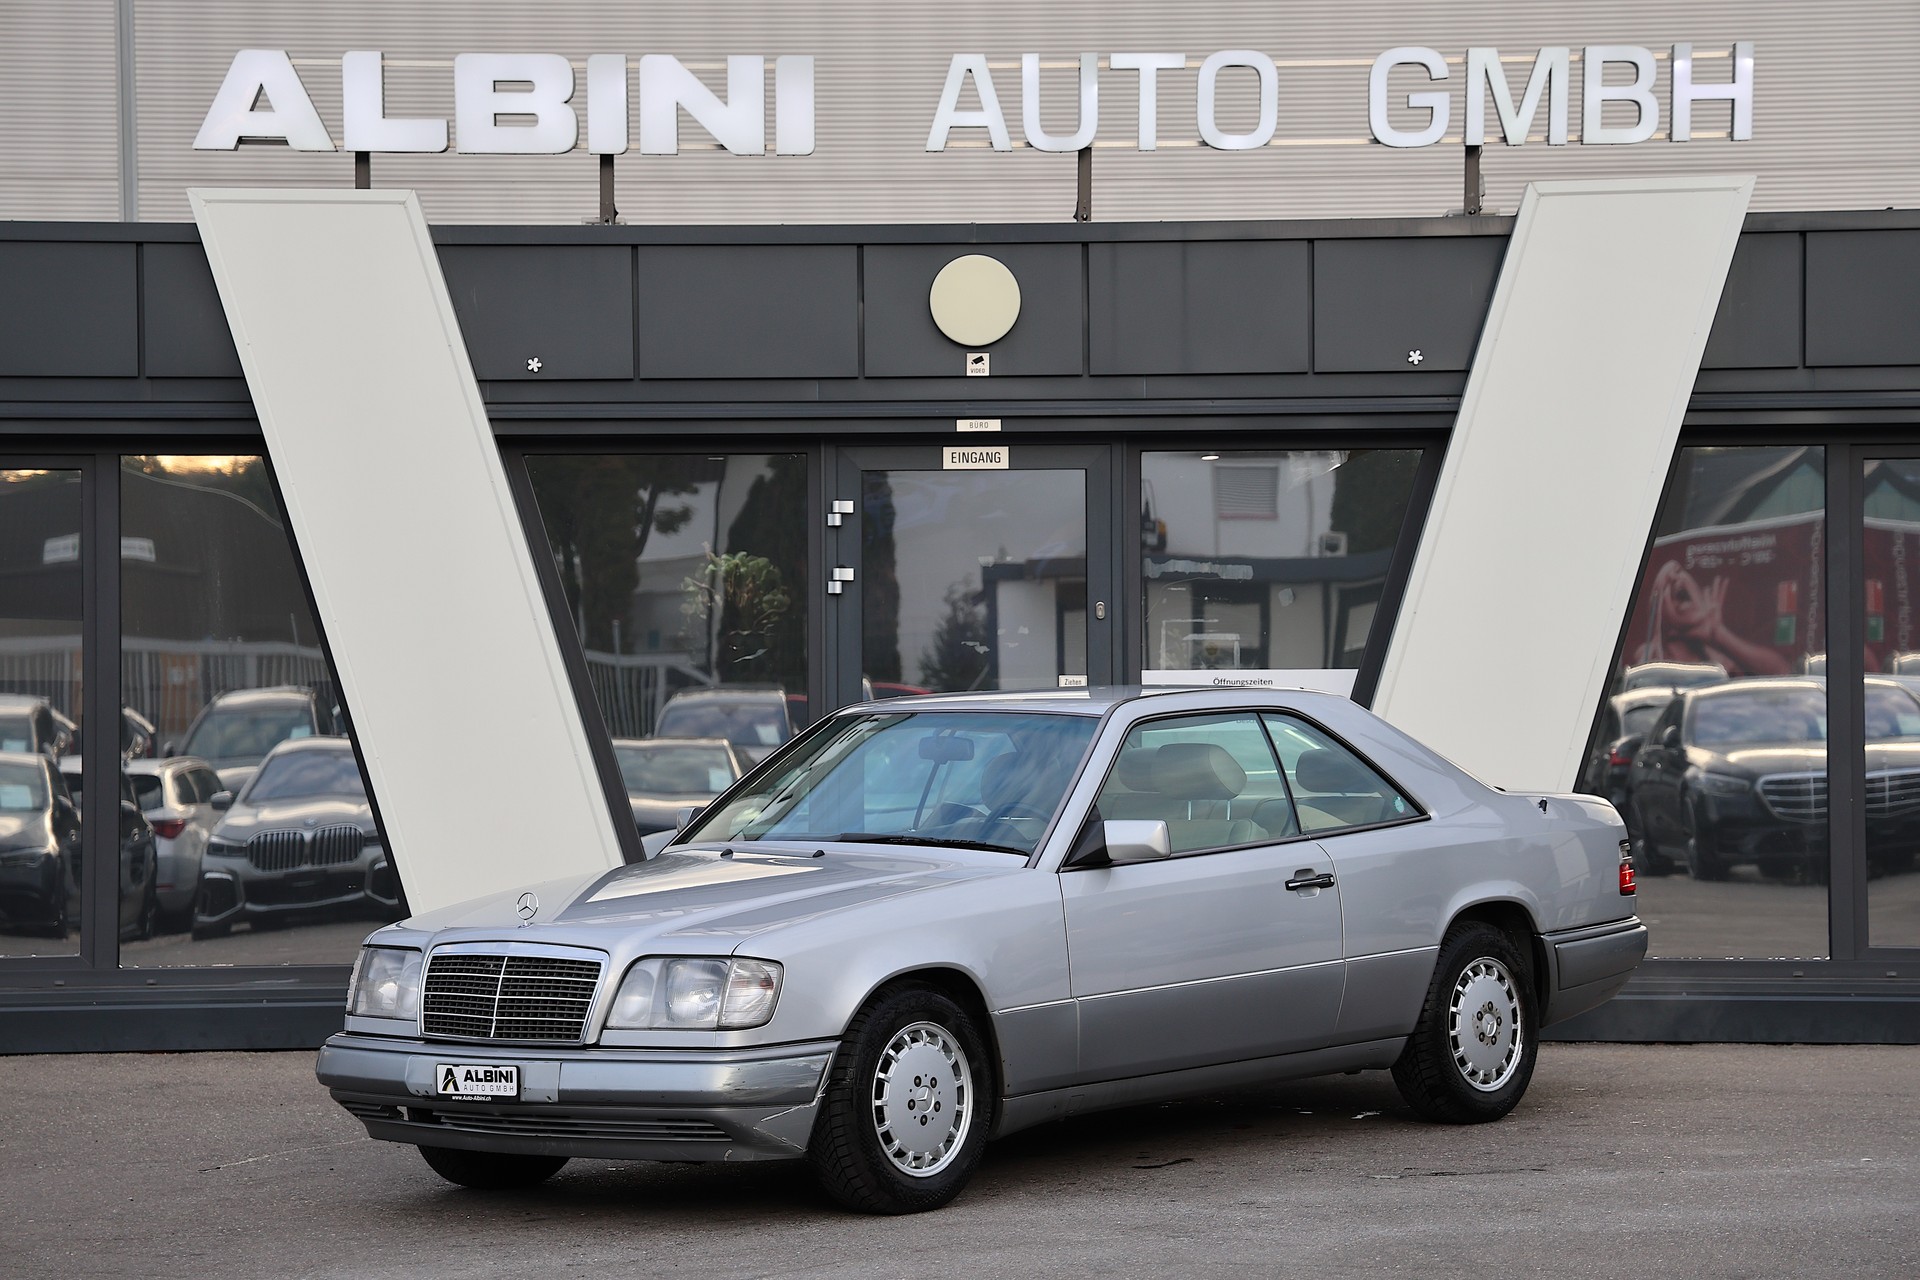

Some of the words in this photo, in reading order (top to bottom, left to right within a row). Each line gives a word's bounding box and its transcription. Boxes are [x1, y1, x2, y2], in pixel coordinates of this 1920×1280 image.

[193, 49, 815, 156] ALBINI
[926, 50, 1279, 153] AUTO
[1367, 41, 1754, 148] GMBH
[969, 421, 989, 429] BÜRO
[951, 451, 1002, 464] EINGANG
[1064, 678, 1082, 686] Ziehen
[1213, 677, 1273, 686] Öffnungszeiten
[463, 1069, 514, 1083] ALBINI
[463, 1084, 486, 1092] AUTO
